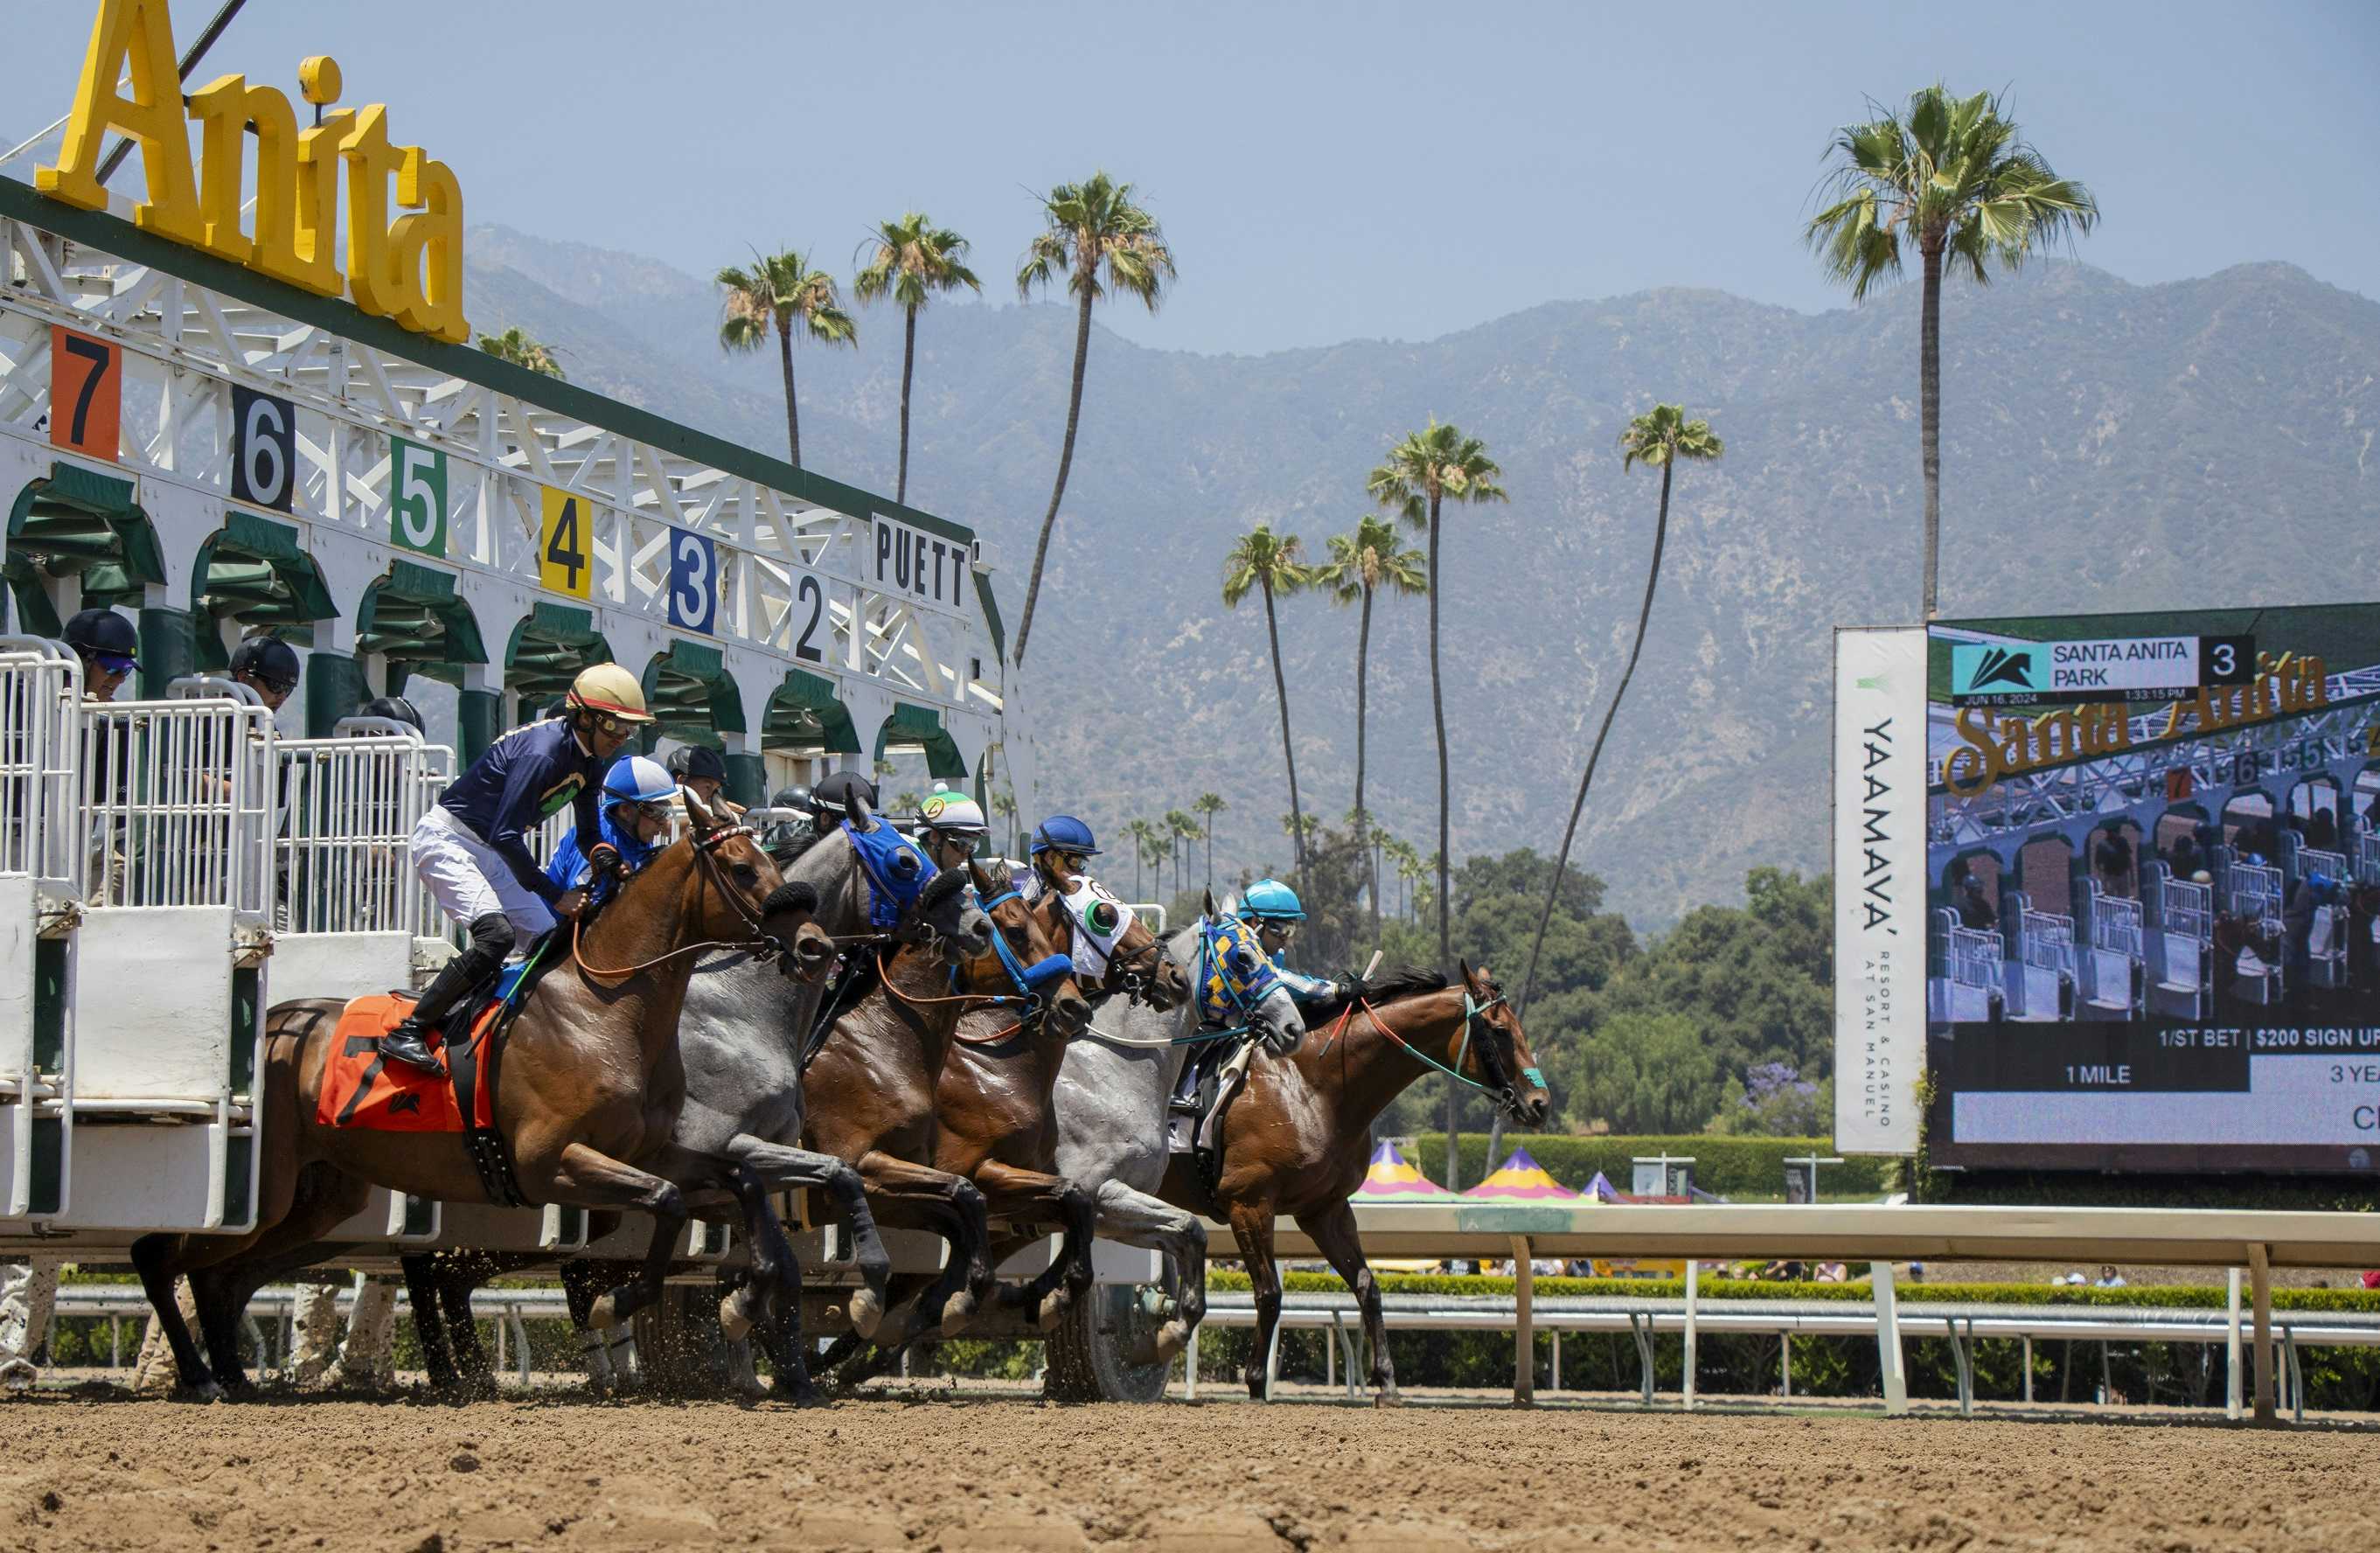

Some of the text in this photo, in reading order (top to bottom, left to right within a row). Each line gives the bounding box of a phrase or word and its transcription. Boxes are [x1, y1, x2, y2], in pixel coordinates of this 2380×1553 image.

[35, 0, 470, 344] Anita
[66, 334, 110, 446] 7
[244, 398, 285, 505] 6
[400, 444, 438, 548] 5
[546, 498, 585, 590] 4
[676, 534, 708, 628] 3
[877, 522, 965, 607] PUETT
[796, 575, 823, 664] 2
[2053, 641, 2189, 663] SANTA ANITA
[2212, 644, 2237, 676] 3
[1965, 695, 1989, 706] JUN
[2009, 693, 2038, 704] 2024
[2054, 667, 2108, 687] PARK
[1943, 703, 2132, 798] Santa
[2237, 754, 2256, 783] 6
[2304, 742, 2321, 768] 5
[1863, 717, 1897, 935] YAAMAVA'
[1881, 951, 1890, 1022] RESORT
[336, 1035, 388, 1125] 7
[1866, 961, 1875, 1118] AT SAN MANUEL
[2066, 1065, 2131, 1083] 1 MILE
[2159, 1028, 2198, 1047] 1/ST
[2203, 1028, 2240, 1047] BET
[2256, 1028, 2300, 1047] $200
[2305, 1028, 2352, 1047] SIGN
[2331, 1065, 2380, 1083] 3 YE
[1881, 1057, 1890, 1126] CASINO
